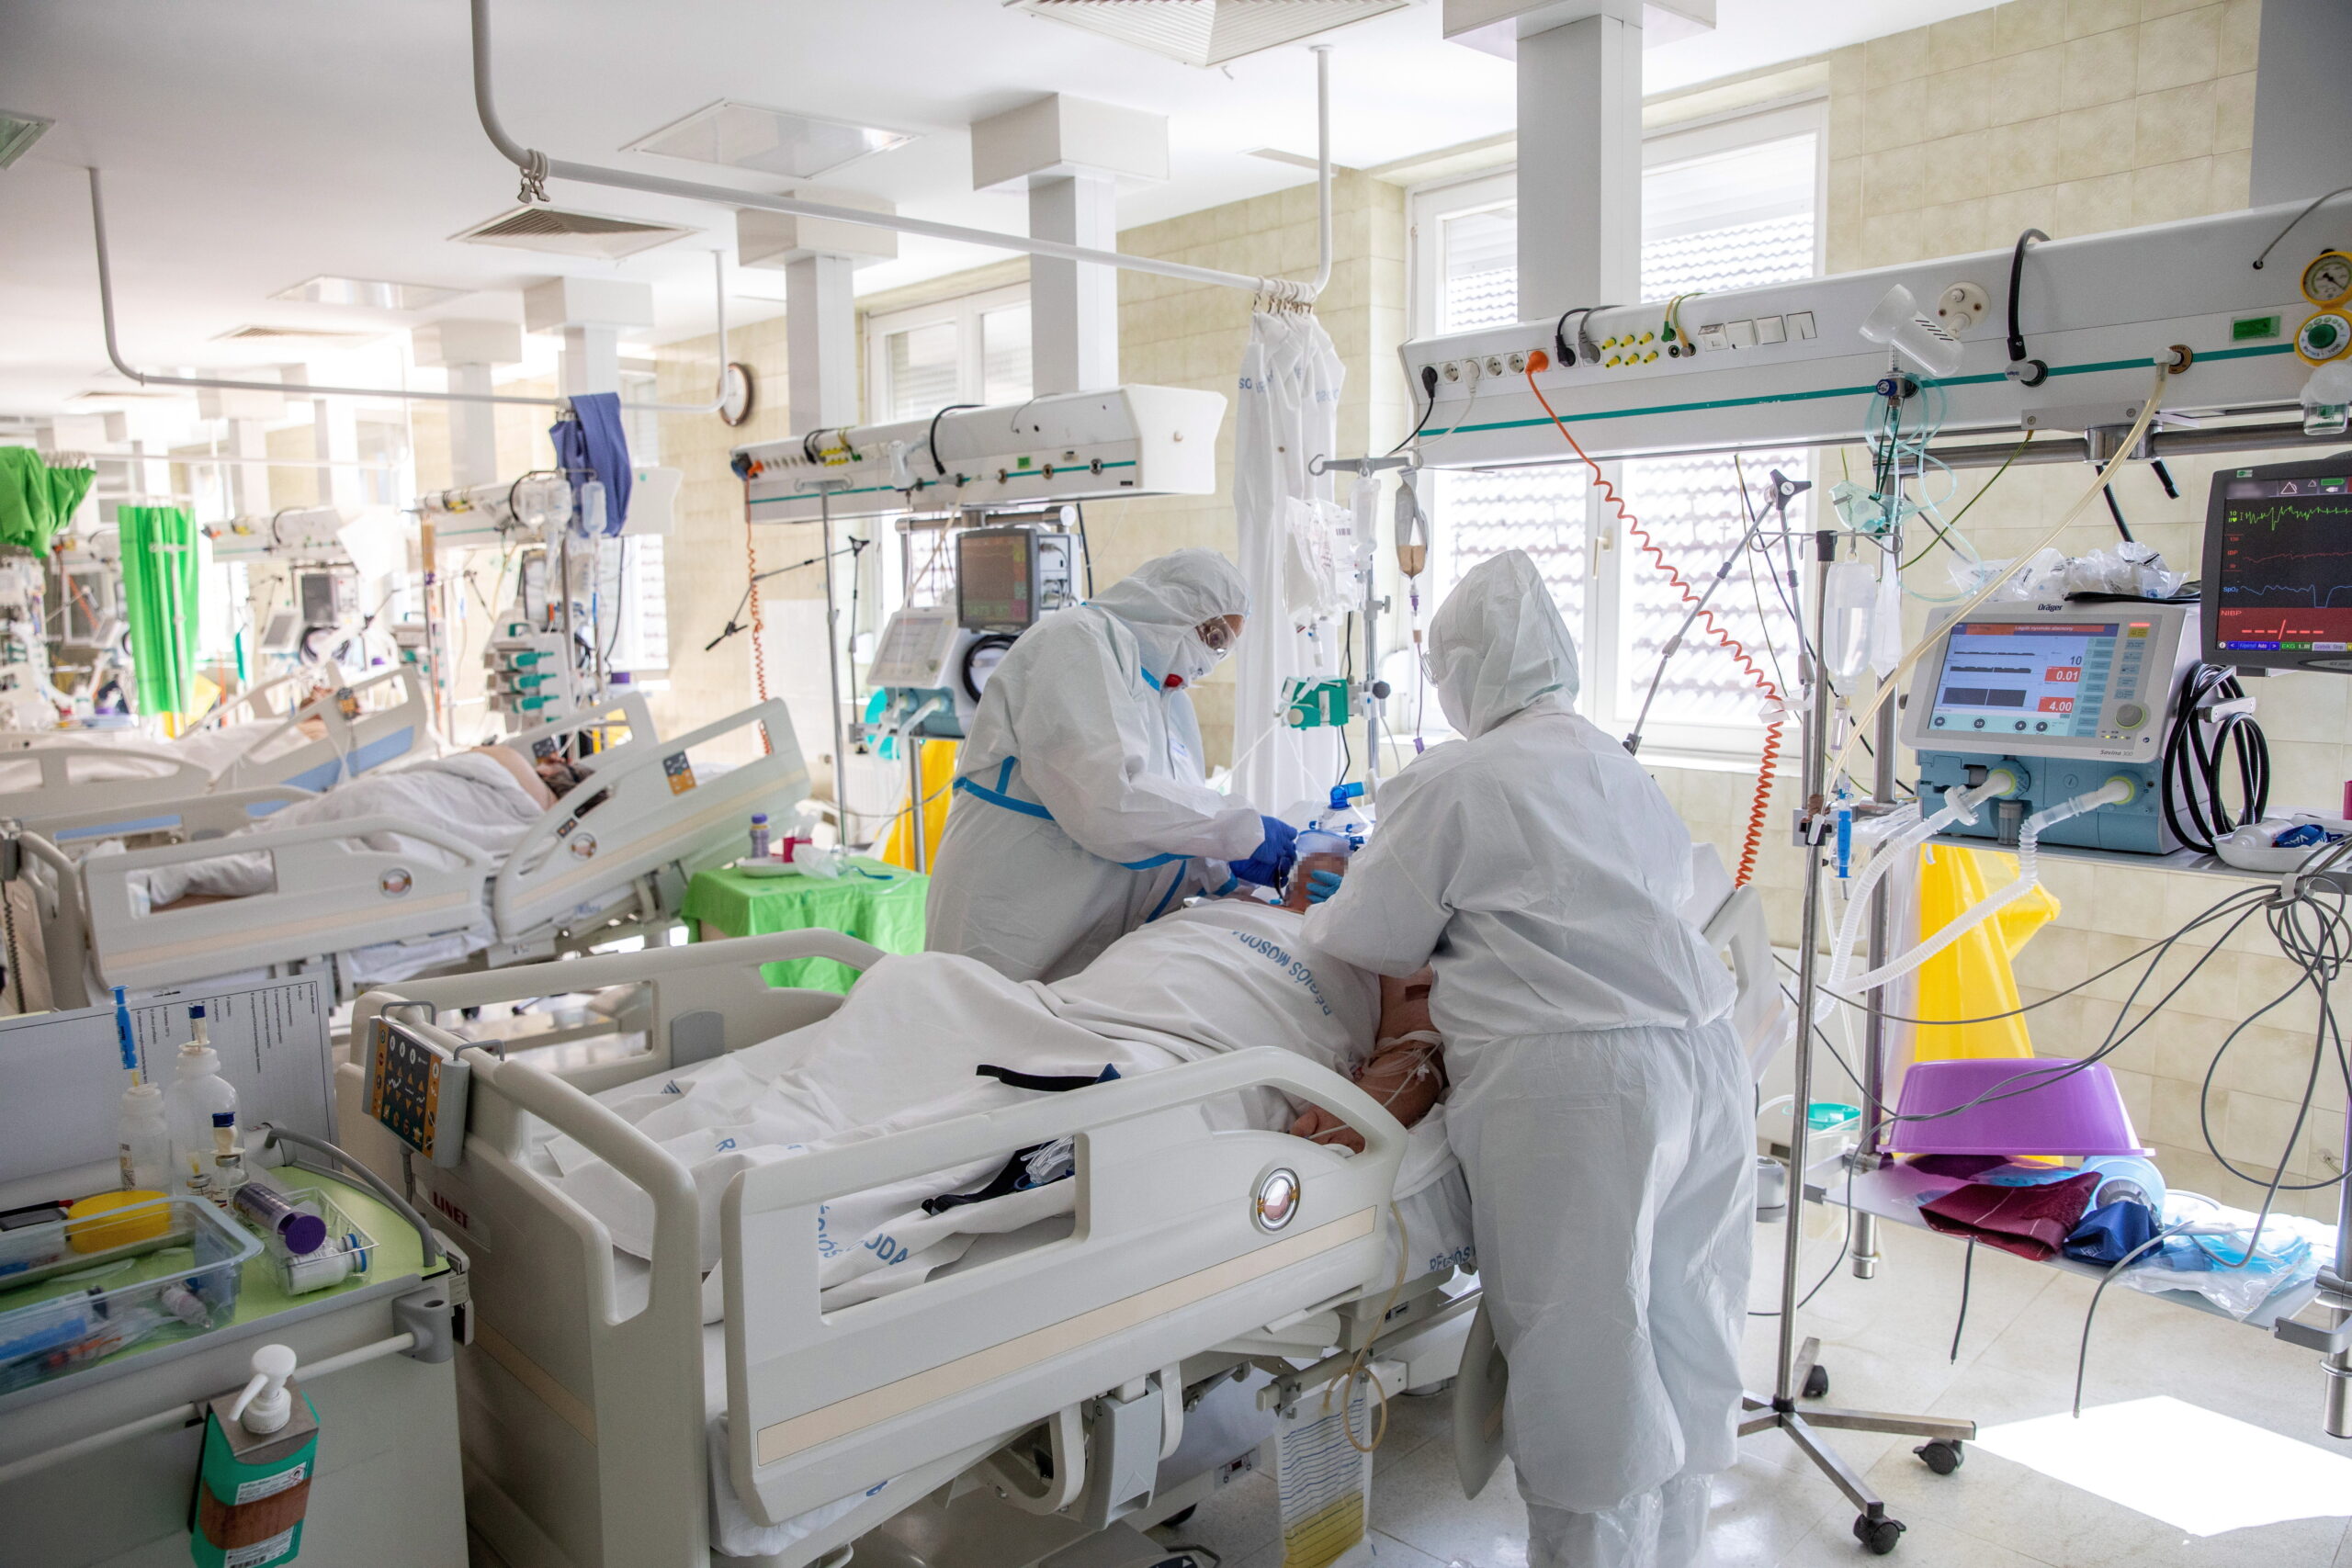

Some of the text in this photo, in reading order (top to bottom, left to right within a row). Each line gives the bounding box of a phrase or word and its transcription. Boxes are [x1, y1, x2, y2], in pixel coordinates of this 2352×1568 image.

[2038, 603, 2064, 613] Dräger
[2070, 655, 2083, 666] 10
[2056, 670, 2079, 682] 0.01
[2049, 700, 2073, 712] 4.00
[433, 1190, 469, 1229] LINET
